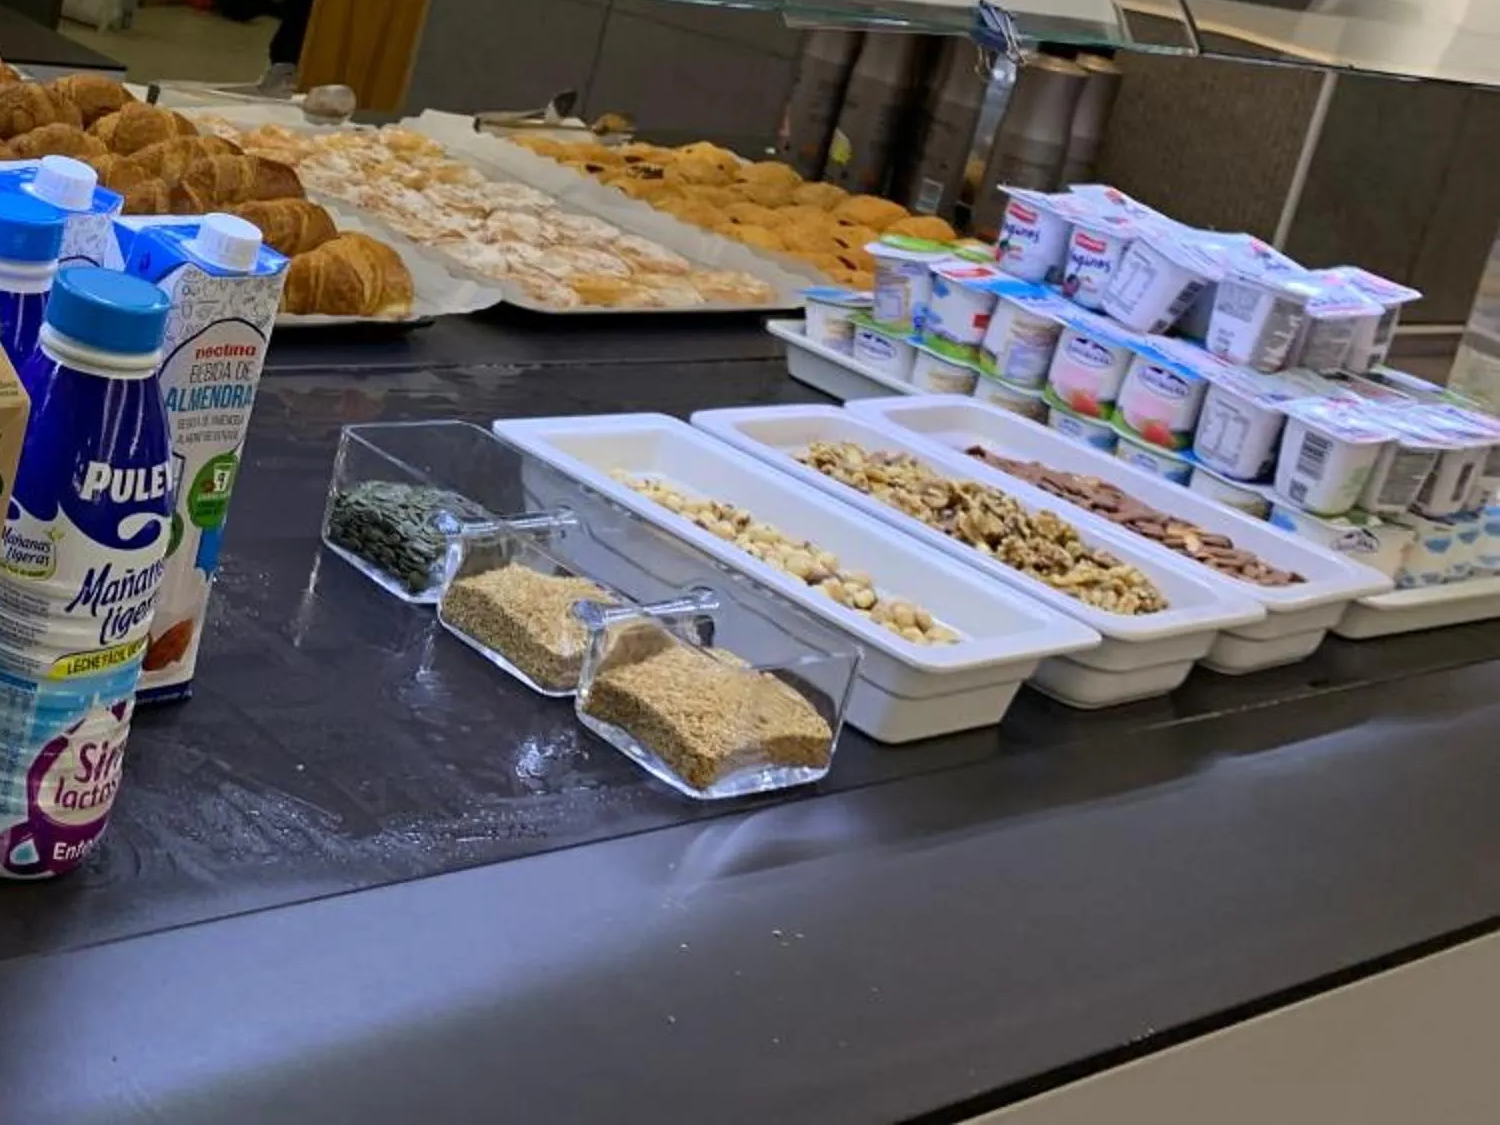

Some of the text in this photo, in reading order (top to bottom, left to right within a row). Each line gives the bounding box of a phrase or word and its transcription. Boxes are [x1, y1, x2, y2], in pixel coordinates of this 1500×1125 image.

[195, 343, 257, 361] nectina
[190, 361, 254, 385] BEBIDA DE
